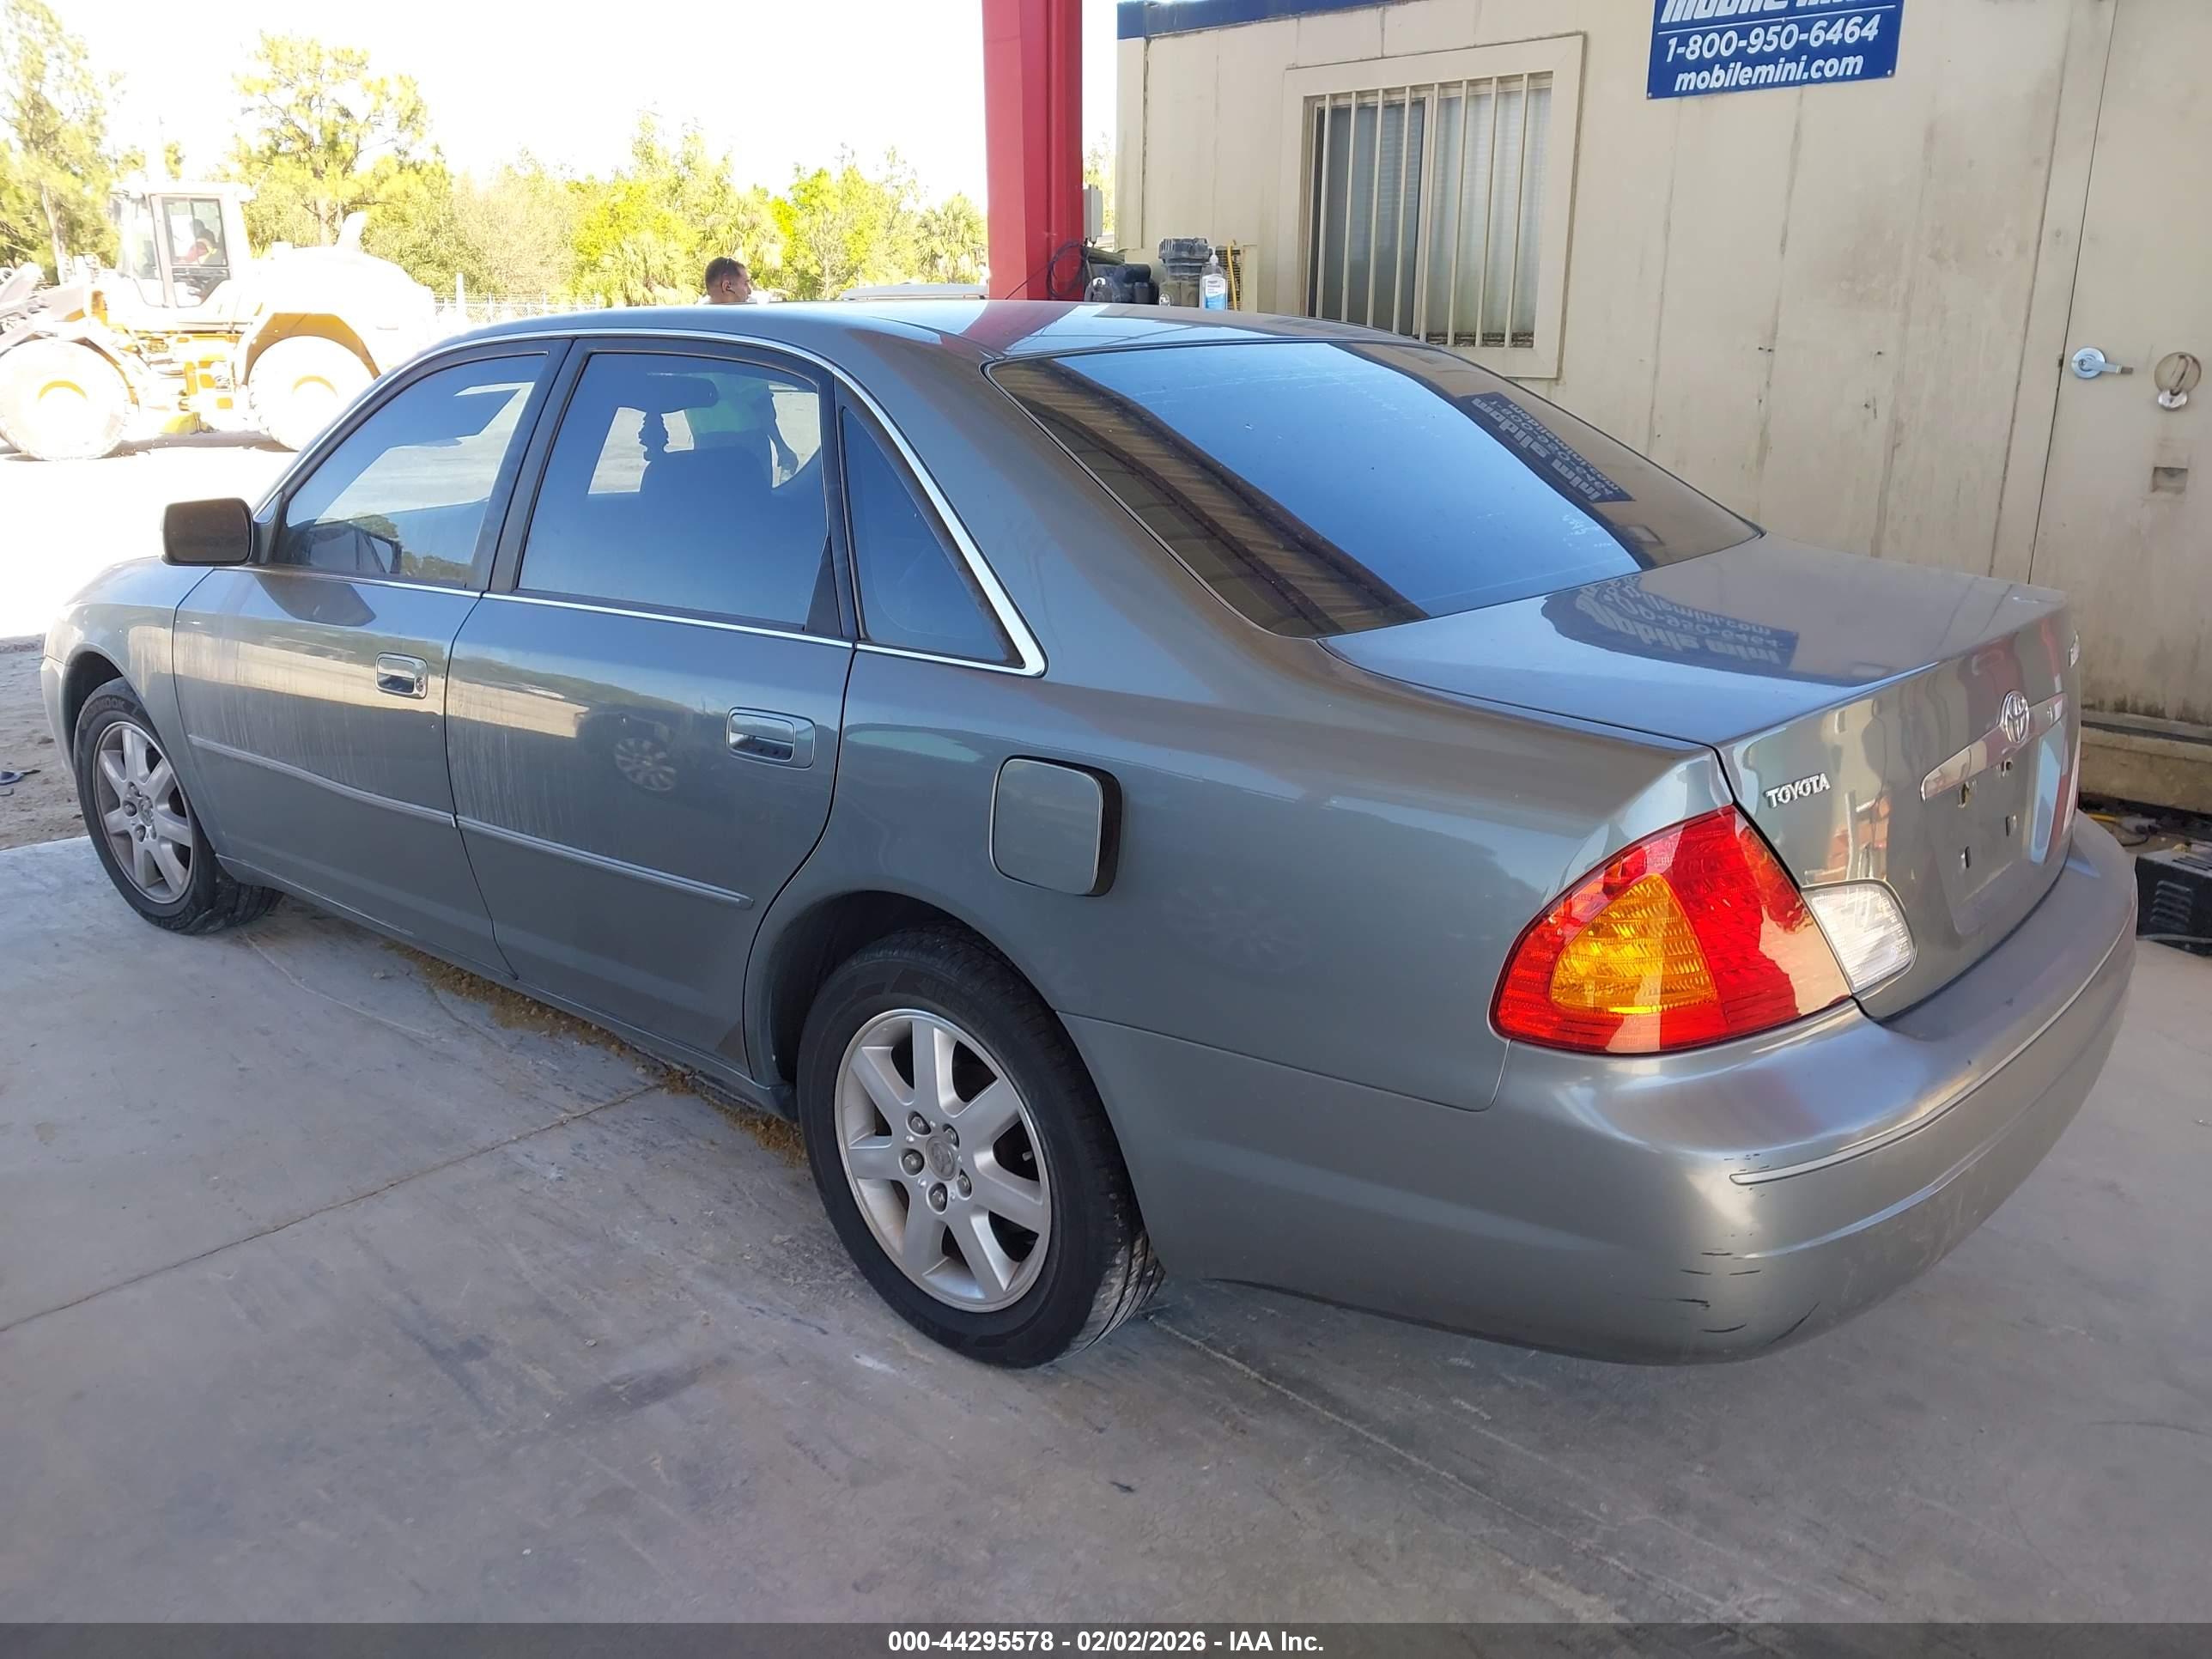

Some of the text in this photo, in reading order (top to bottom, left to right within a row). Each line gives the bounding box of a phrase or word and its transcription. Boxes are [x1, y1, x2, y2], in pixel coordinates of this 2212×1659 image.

[1661, 0, 1788, 23] mob
[1666, 15, 1881, 63] 1-800-950-6464
[1674, 55, 1863, 92] mobilemini.com
[1765, 773, 1830, 808] TOYOTA
